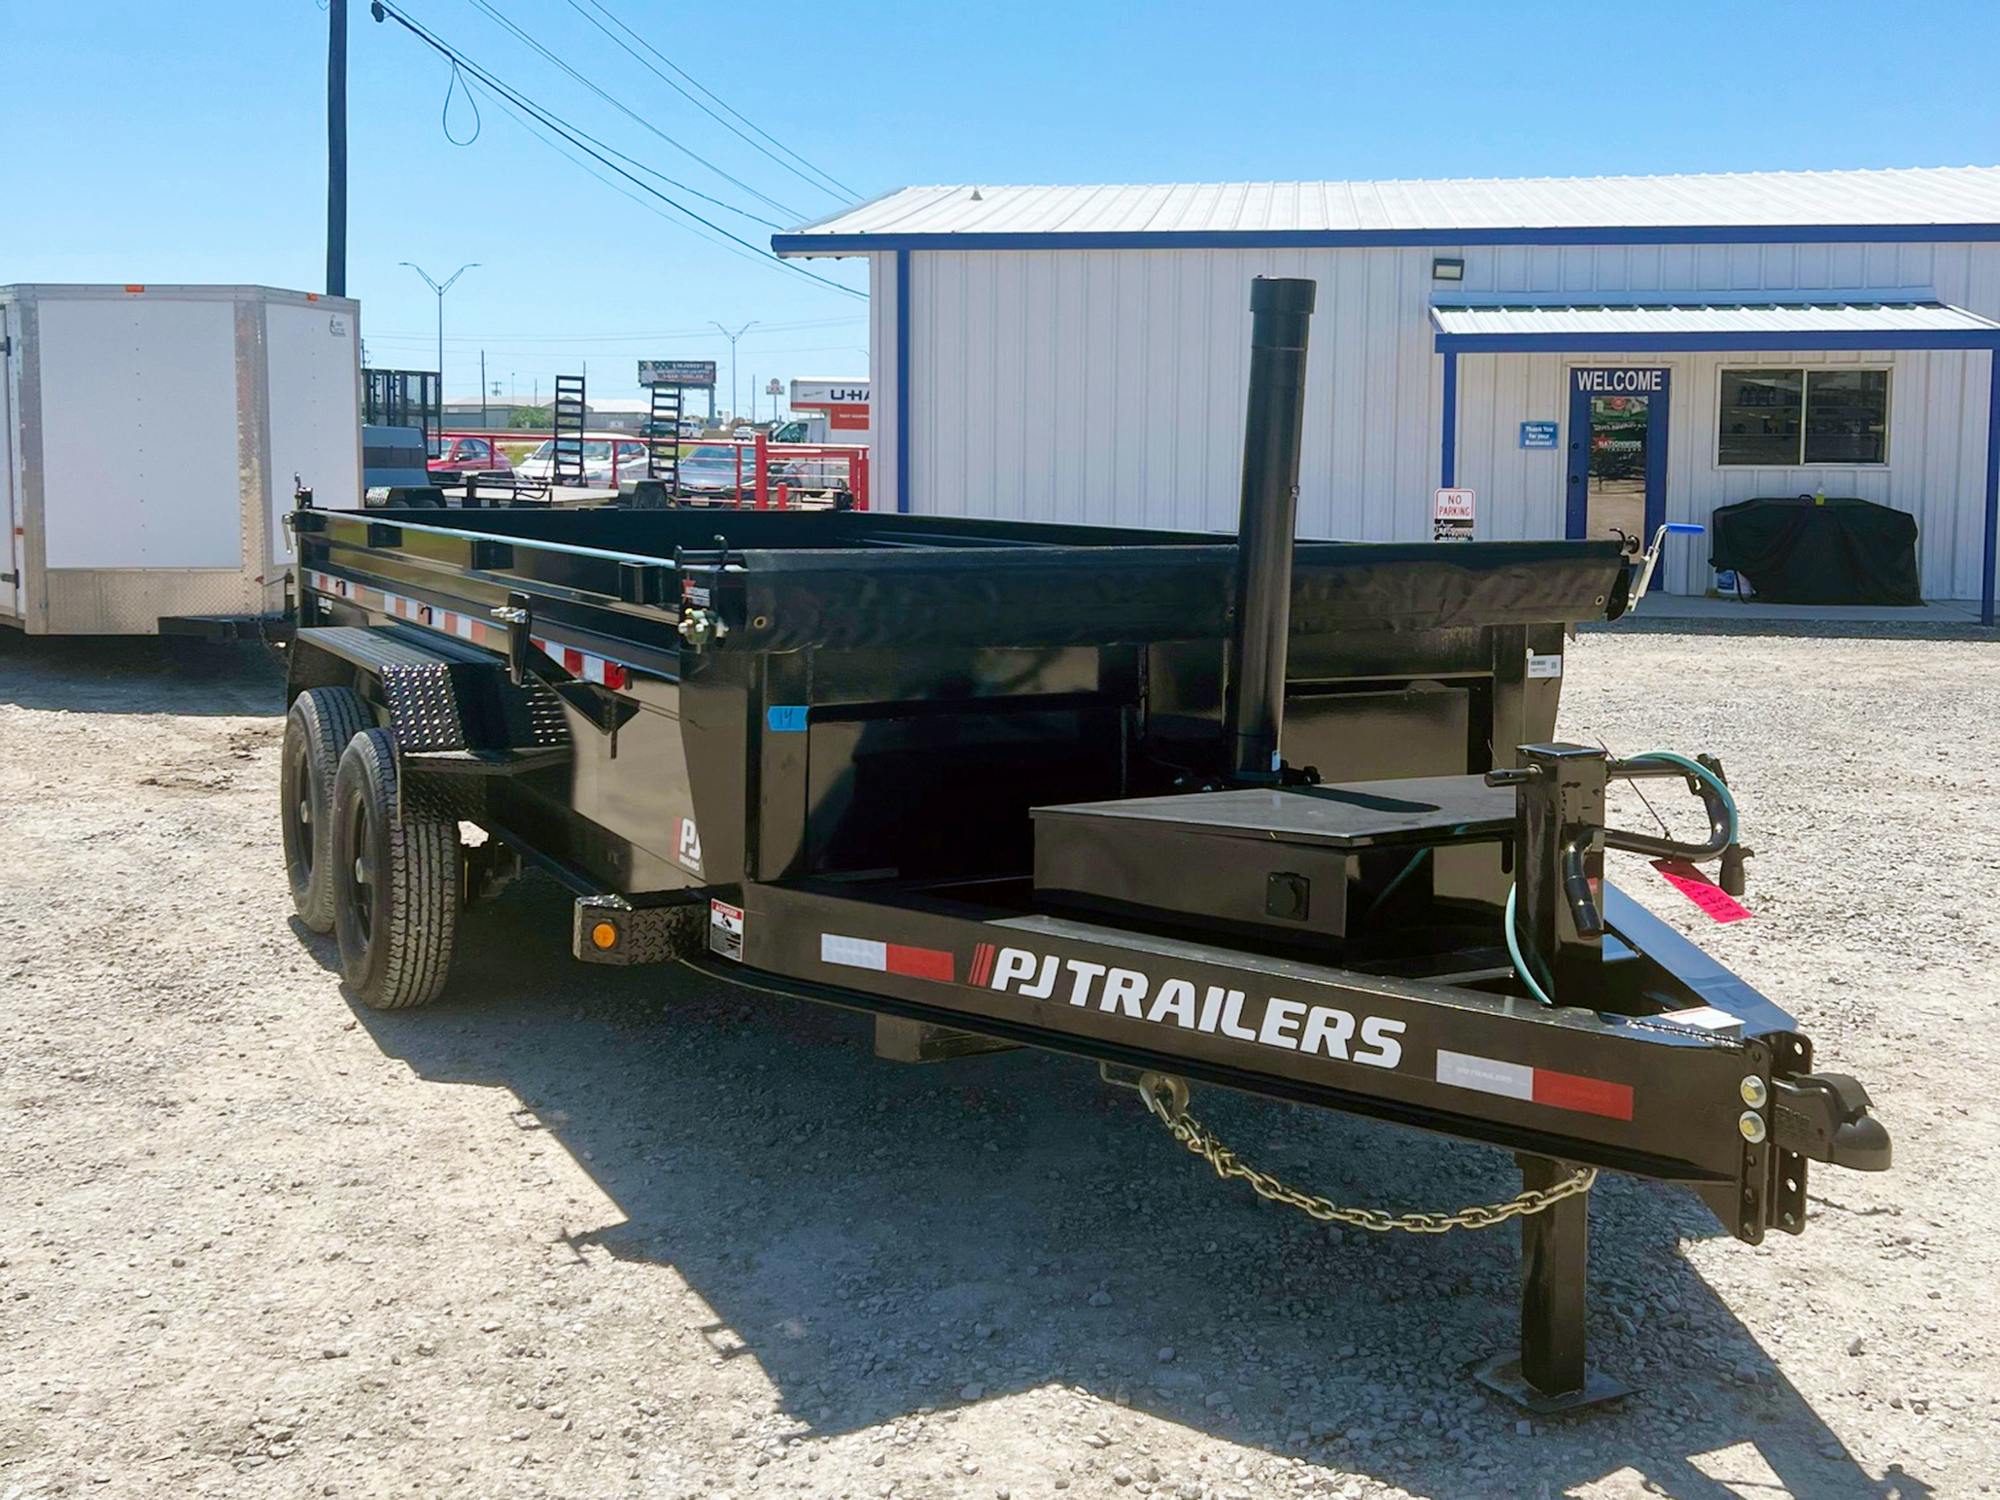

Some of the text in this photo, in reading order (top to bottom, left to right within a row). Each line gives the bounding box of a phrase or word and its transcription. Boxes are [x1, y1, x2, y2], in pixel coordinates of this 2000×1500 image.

[1577, 371, 1662, 391] WELCOME
[1448, 495, 1462, 505] NO
[1439, 506, 1471, 516] PARKING
[991, 947, 1407, 1069] PJ TRAILERS
